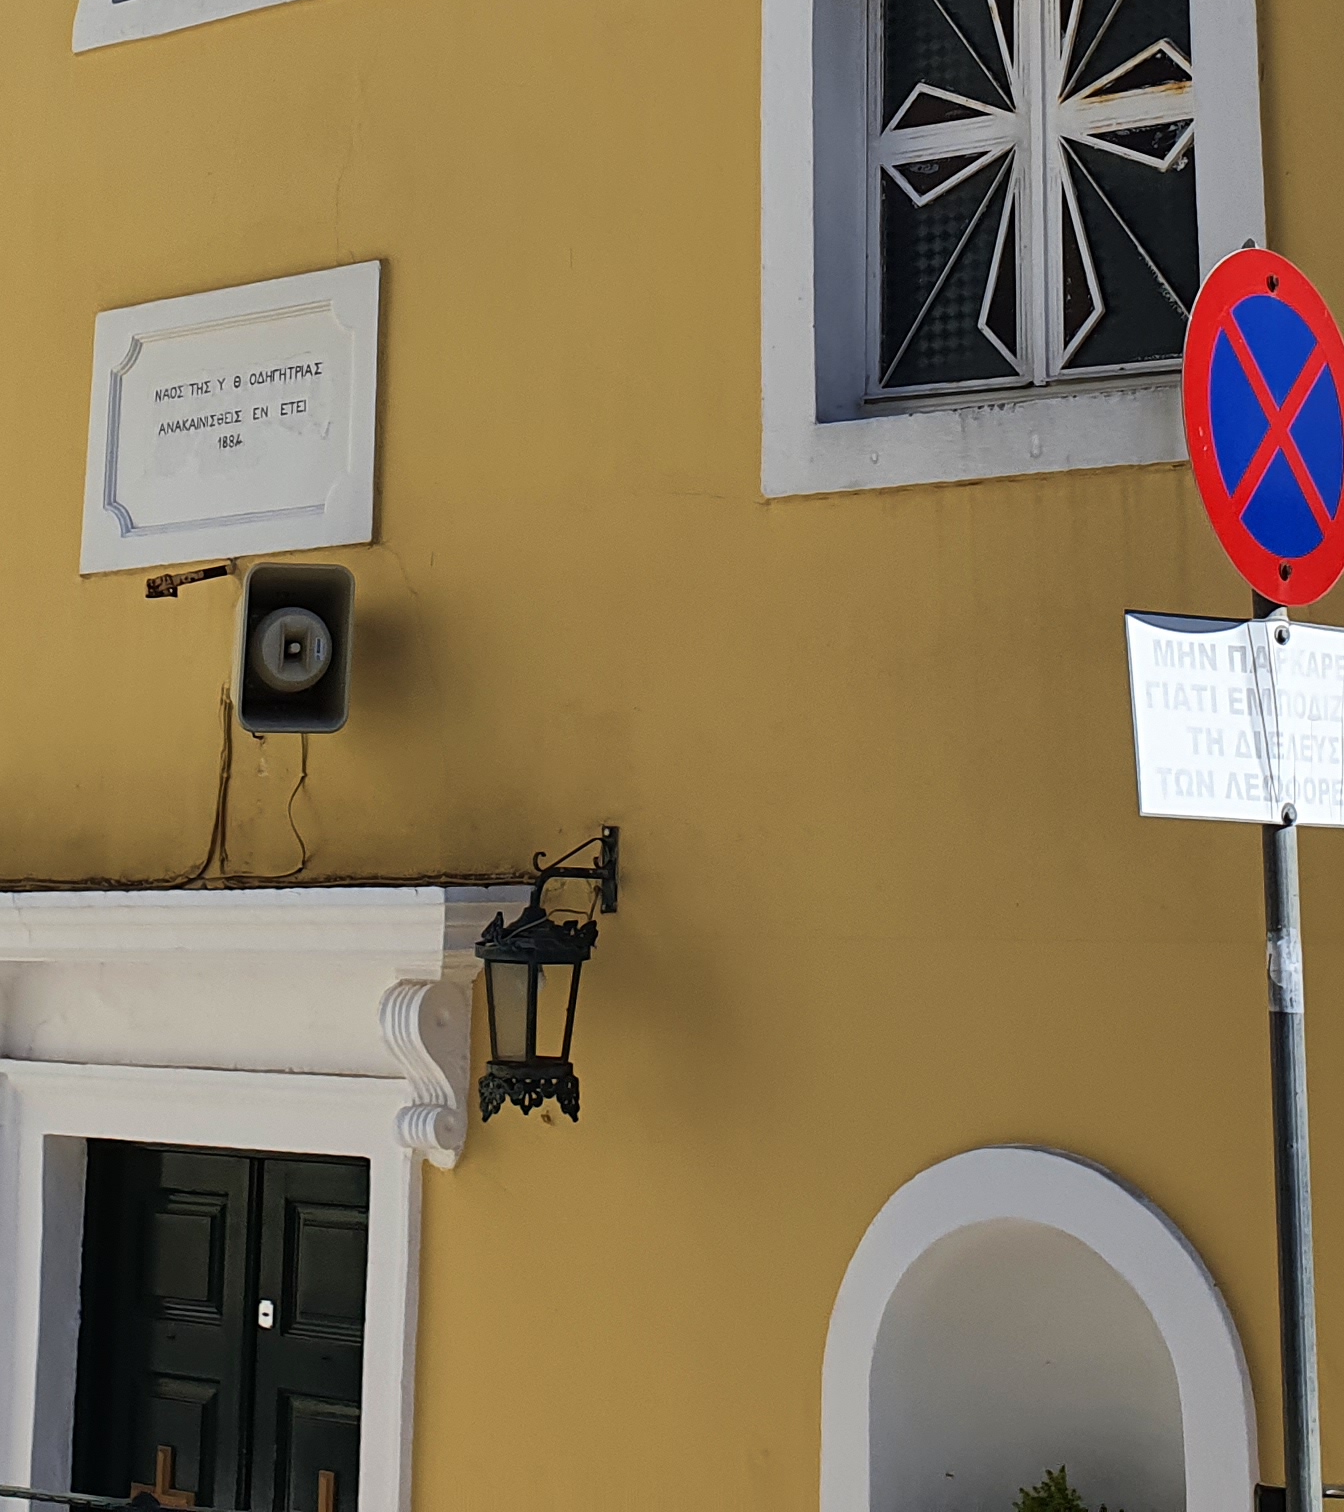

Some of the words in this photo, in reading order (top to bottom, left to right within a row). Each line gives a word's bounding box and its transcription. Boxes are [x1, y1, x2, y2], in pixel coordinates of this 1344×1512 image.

[155, 385, 184, 403] ΝΑΟΣ
[189, 380, 212, 396] ΤΗΣ
[217, 377, 226, 391] Υ
[233, 375, 242, 388] Θ
[249, 362, 323, 386] ΟΔΗΓΗΤΡΙΑΣ
[253, 406, 269, 421] ΕΝ
[280, 400, 307, 417] ΕΤΕΙ
[1152, 639, 1218, 671] ΜΗΝ
[1145, 681, 1217, 713] ΓΙΑΤΙ
[1186, 726, 1224, 756] ΤΗ
[1156, 767, 1214, 799] ΤΩΝ
